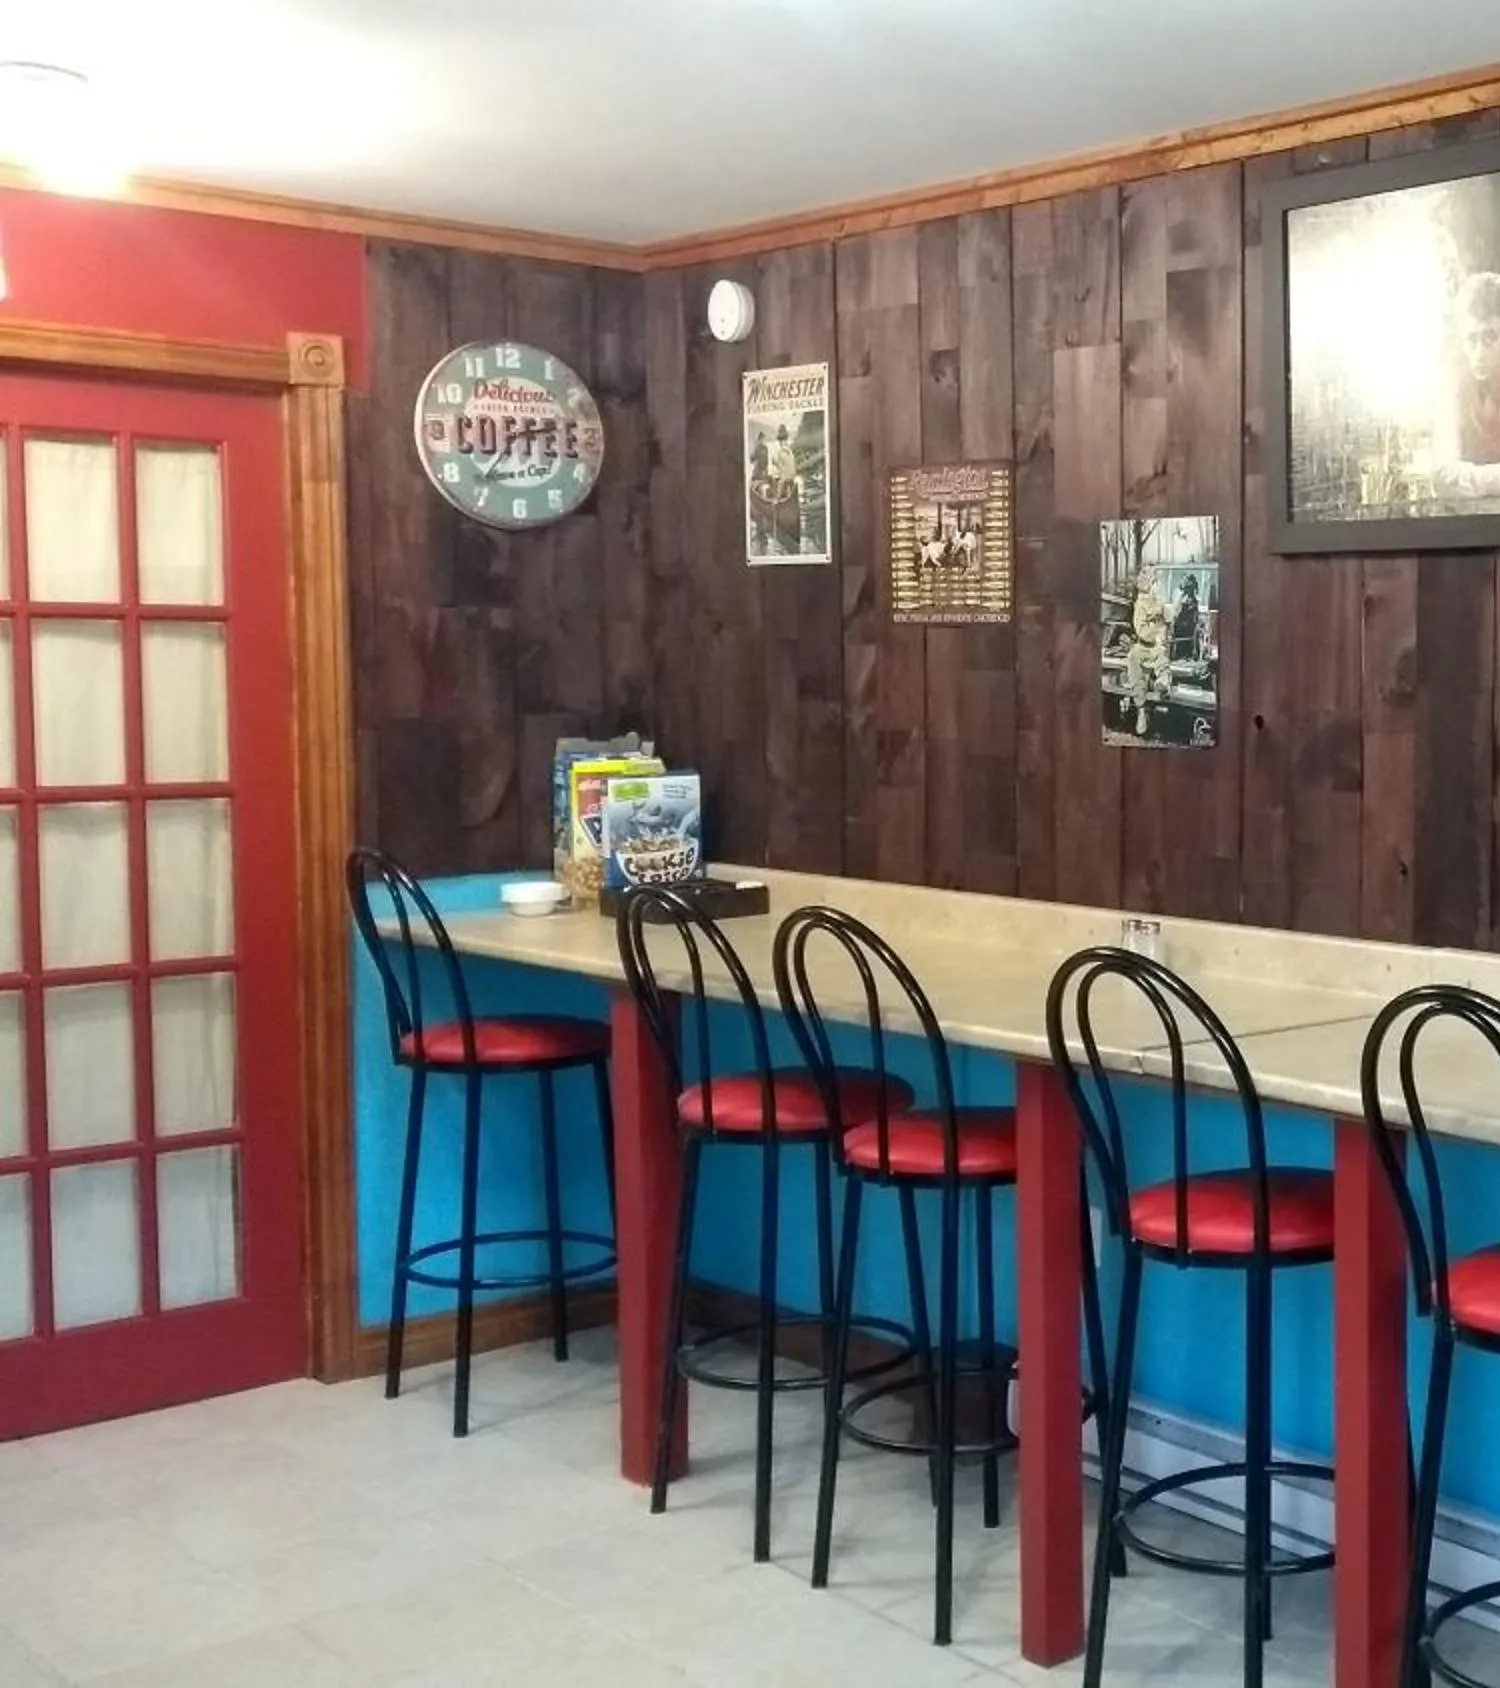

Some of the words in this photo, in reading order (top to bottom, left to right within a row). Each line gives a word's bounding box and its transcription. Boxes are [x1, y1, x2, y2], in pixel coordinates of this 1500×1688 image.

[464, 357, 486, 378] 11
[494, 347, 521, 369] 12
[544, 360, 554, 381] 1
[436, 383, 462, 404] 10
[746, 376, 825, 404] WINCHESTER
[456, 414, 579, 459] COFFEE
[443, 461, 460, 483] 8
[474, 486, 489, 507] 7
[547, 489, 563, 510] 5
[512, 499, 528, 519] 6
